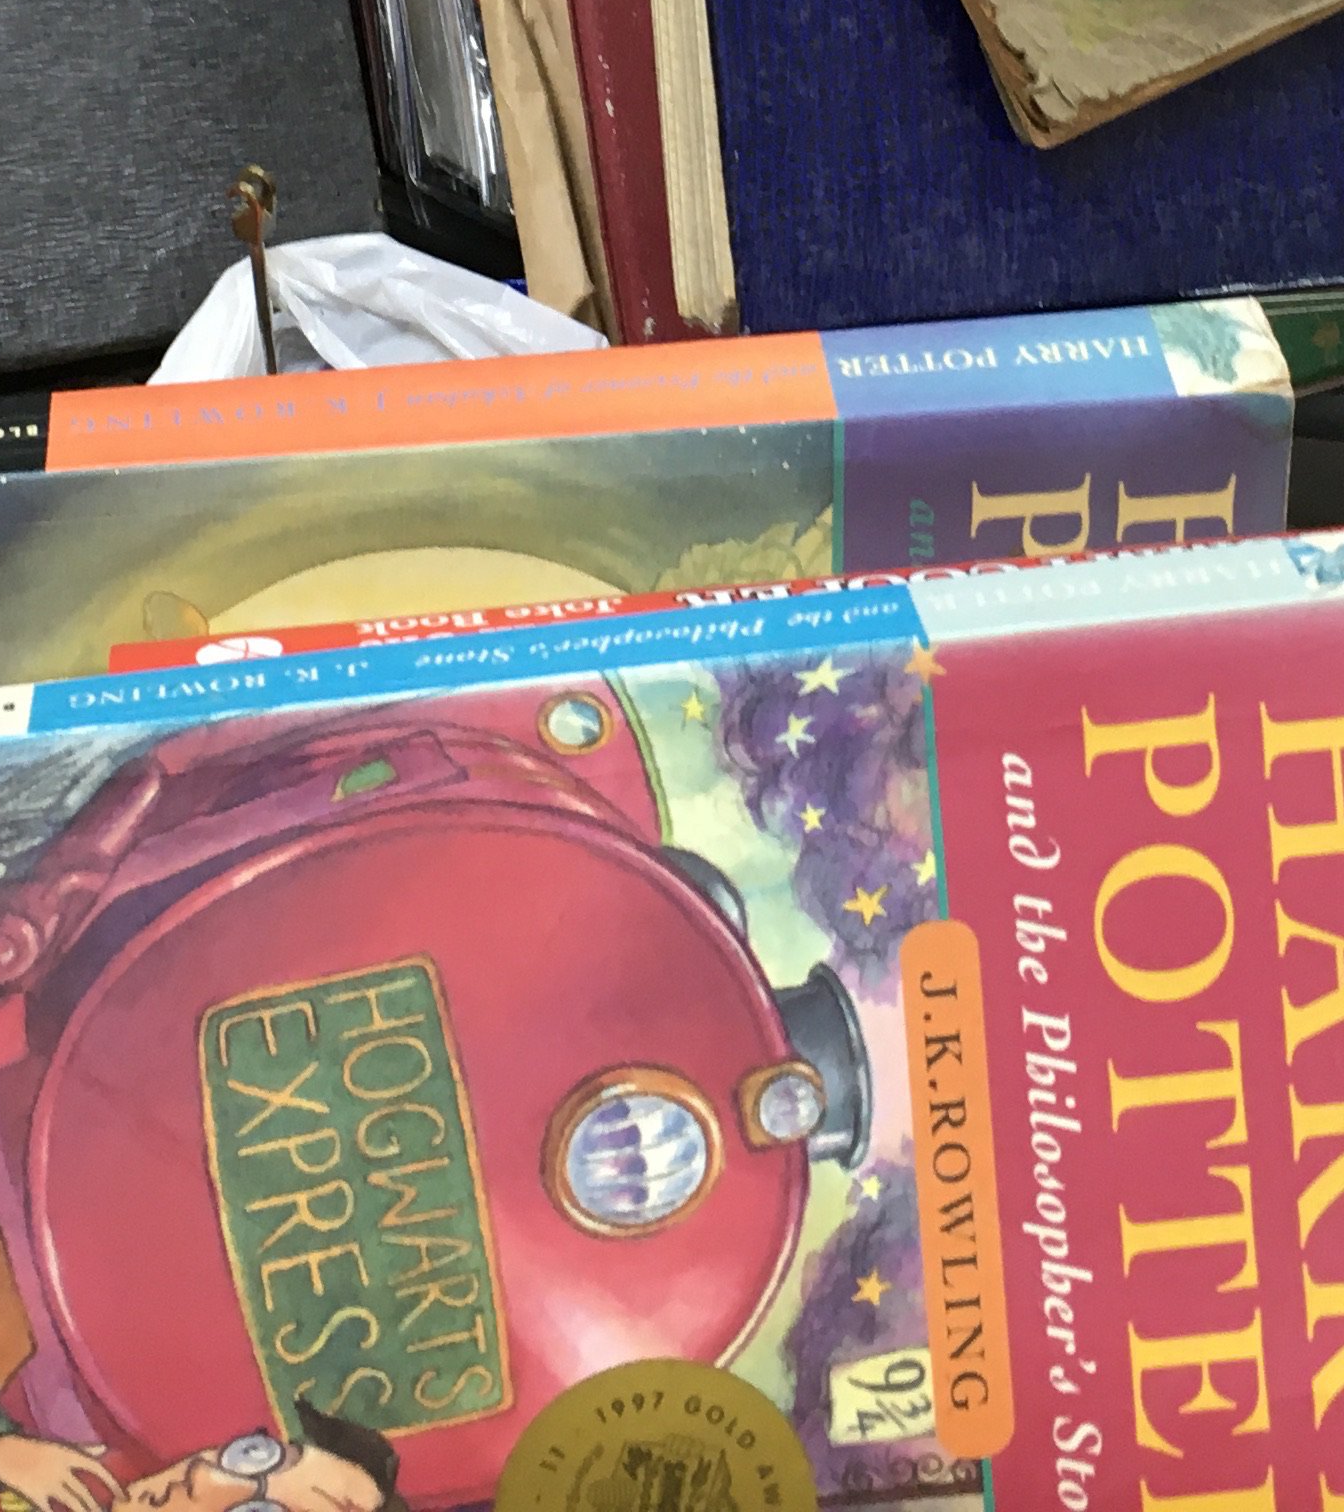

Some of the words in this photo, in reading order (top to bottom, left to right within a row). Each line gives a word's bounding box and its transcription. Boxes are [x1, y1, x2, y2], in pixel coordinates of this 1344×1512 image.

[836, 345, 999, 378] POTTER
[1014, 335, 1152, 366] HARRY
[786, 604, 836, 629] the
[284, 666, 319, 685] K.
[414, 642, 514, 672] Stone
[69, 673, 267, 709] ROWLING
[1003, 754, 1061, 870] and
[1012, 892, 1068, 986] the
[219, 1002, 393, 1416] EXPRESS
[324, 976, 494, 1409] HOGWARTS
[1022, 1009, 1100, 1396] Philosopher's
[594, 1391, 664, 1423] 1997
[684, 1395, 756, 1450] GOLD
